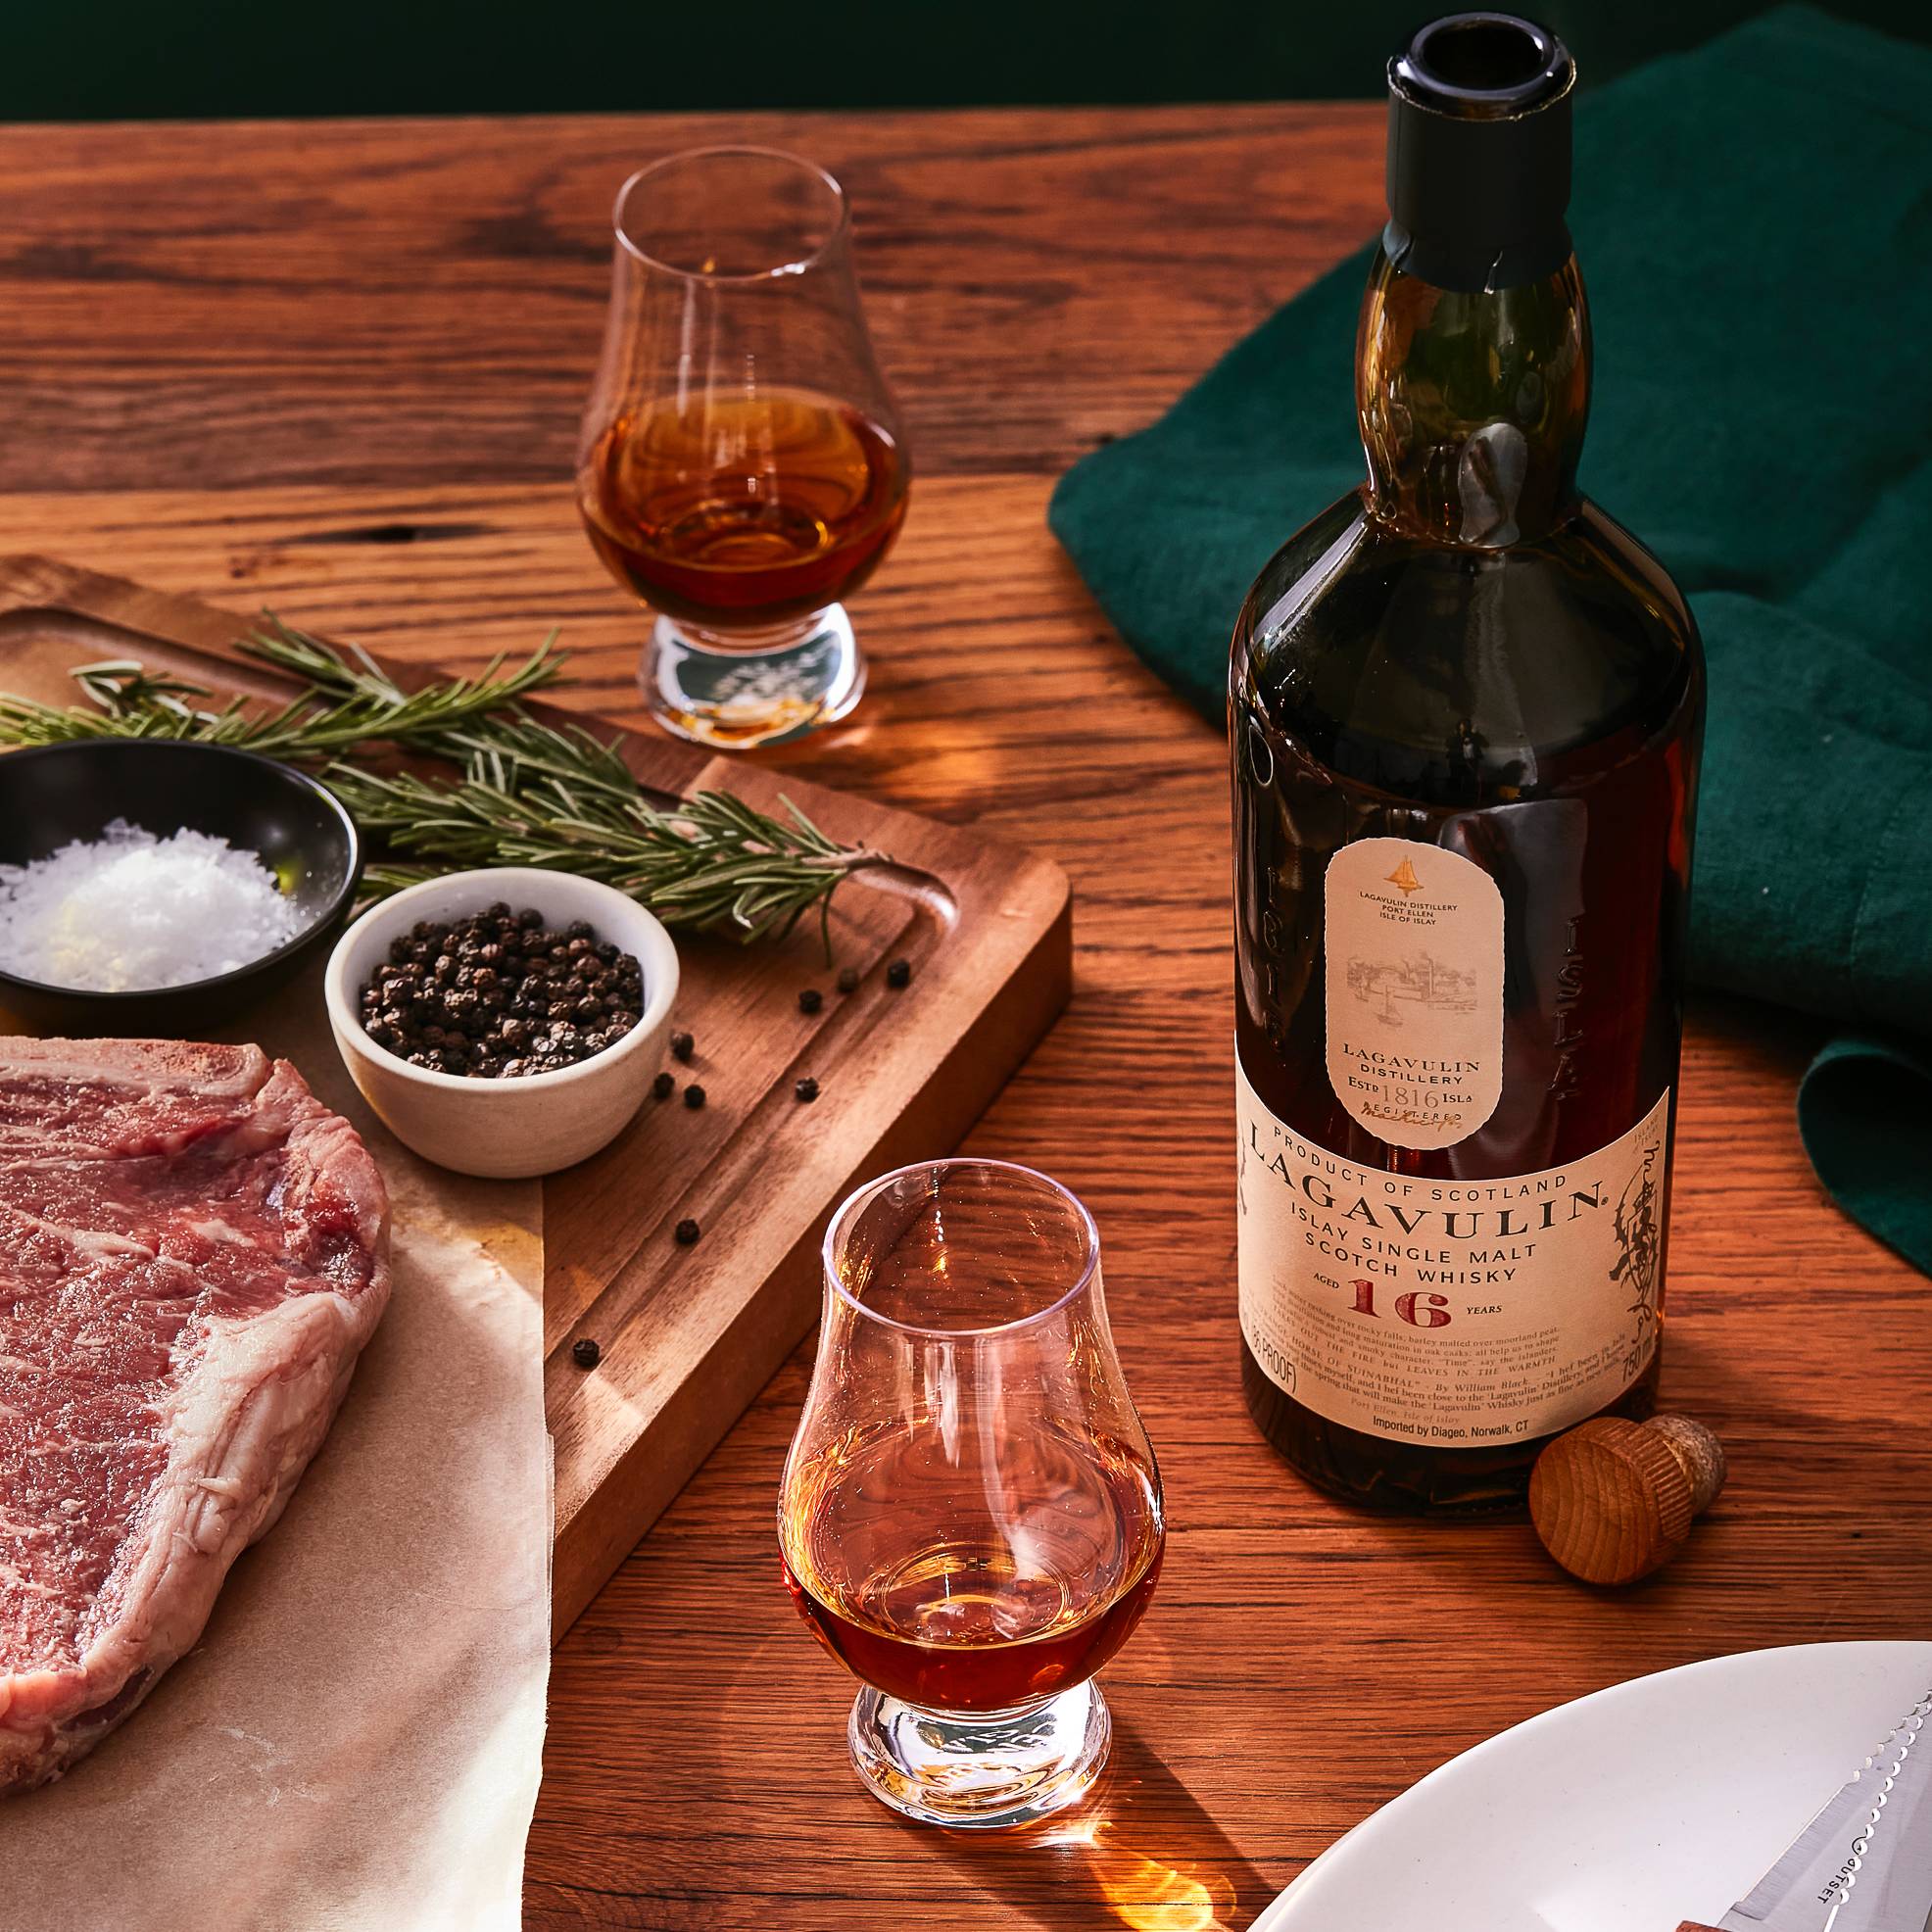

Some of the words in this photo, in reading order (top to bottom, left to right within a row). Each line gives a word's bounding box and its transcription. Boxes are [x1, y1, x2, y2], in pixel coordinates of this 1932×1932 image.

[1360, 891, 1408, 908] LAGAVULIN
[1410, 901, 1458, 911] DISTILLERY
[1381, 904, 1404, 915] PORT
[1407, 909, 1434, 918] ELLEN
[1379, 911, 1396, 921] ISLE
[1398, 915, 1411, 924] OF
[1343, 1042, 1481, 1073] LAGAVULIN
[1360, 1063, 1463, 1085] DISTILLERY
[1381, 1085, 1439, 1109] 1816
[1250, 1119, 1604, 1239] LAGAVULIN
[1274, 1126, 1368, 1186] PRODUCT
[1383, 1182, 1413, 1196] OF
[1431, 1175, 1567, 1202] SCOTLAND
[1291, 1201, 1348, 1241] ISLAY
[1362, 1236, 1451, 1264] SINGLE
[1470, 1243, 1536, 1264] MALT
[1305, 1232, 1397, 1277] SCOTCH
[1417, 1268, 1517, 1284] WHISKY
[1313, 1273, 1340, 1289] AGED
[1347, 1279, 1452, 1328] 16
[1465, 1304, 1504, 1315] YEARS
[1363, 1334, 1410, 1352] maturation
[1490, 1346, 1510, 1357] help
[1535, 1335, 1560, 1348] shape
[1409, 1334, 1436, 1348] barley
[1496, 1332, 1537, 1345] moorland
[1262, 1336, 1297, 1393] PROOF)
[1292, 1335, 1324, 1361] HORSE
[1327, 1356, 1341, 1368] OF
[1435, 1382, 1449, 1393] By
[1454, 1380, 1496, 1392] William
[1352, 1351, 1375, 1365] FIRE
[1407, 1365, 1449, 1377] LEAVES
[1457, 1369, 1469, 1377] IN
[1477, 1368, 1502, 1377] THE
[1507, 1356, 1557, 1373] WARMTH
[1621, 1344, 1641, 1383] 750
[1315, 1369, 1342, 1389] spring
[1362, 1389, 1380, 1401] will
[1382, 1395, 1408, 1407] make
[1411, 1400, 1426, 1410] the
[1487, 1397, 1524, 1409] Whisky
[1405, 1388, 1425, 1401] been
[1428, 1392, 1453, 1402] close
[1456, 1393, 1468, 1402] to
[1469, 1392, 1484, 1402] the
[1373, 1415, 1414, 1434] Imported
[1417, 1424, 1429, 1438] by
[1431, 1425, 1469, 1440] Diageo,
[1471, 1423, 1513, 1437] Norwalk,
[1515, 1420, 1529, 1433] CT
[1817, 1858, 1856, 1905] OUTSET
